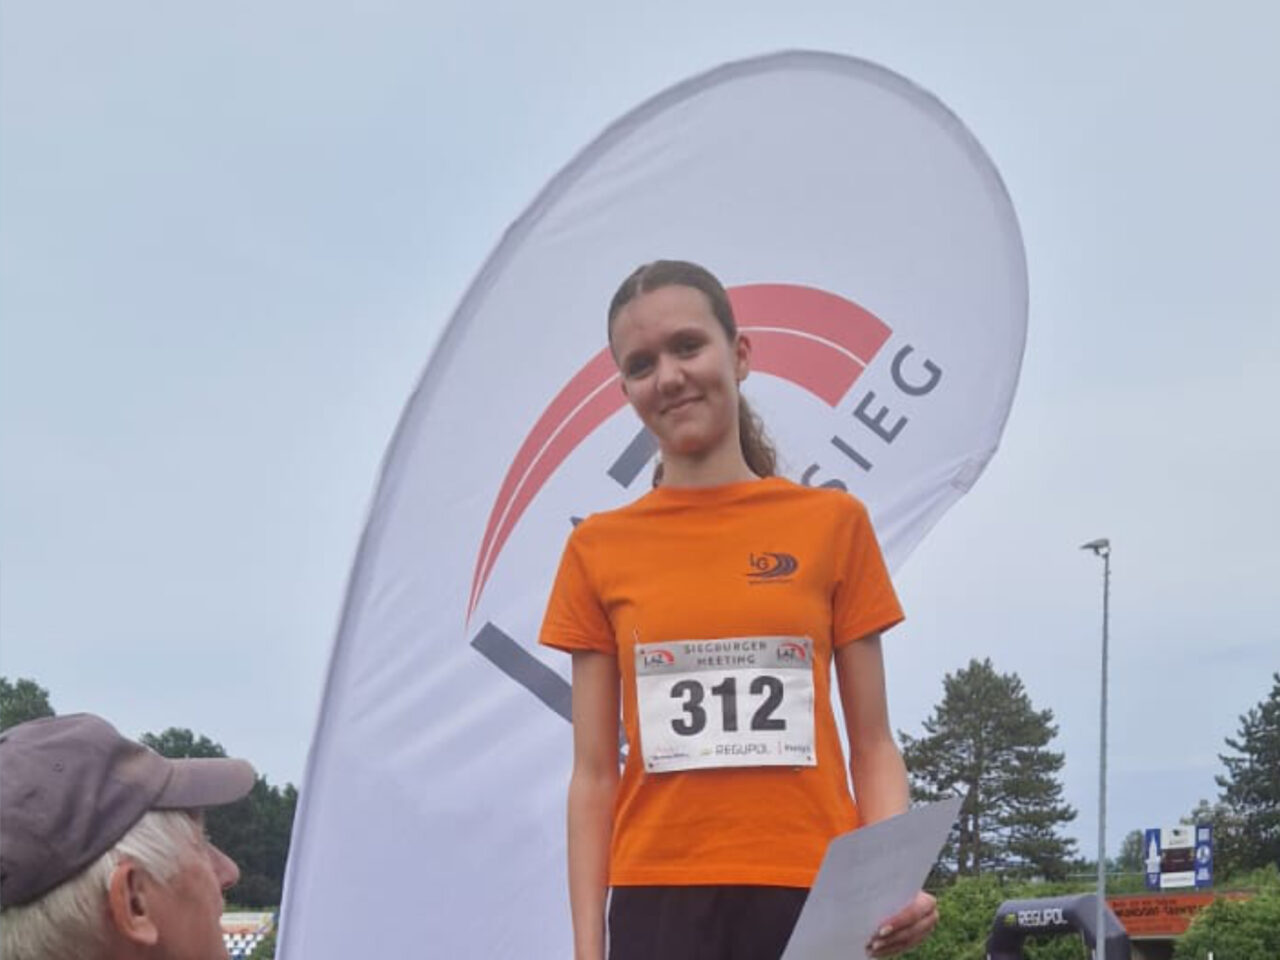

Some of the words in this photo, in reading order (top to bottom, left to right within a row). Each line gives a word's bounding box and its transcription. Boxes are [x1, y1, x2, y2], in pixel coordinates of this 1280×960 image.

[683, 640, 768, 655] SIEGBURGER
[696, 654, 756, 667] MEETING
[669, 674, 787, 737] 312
